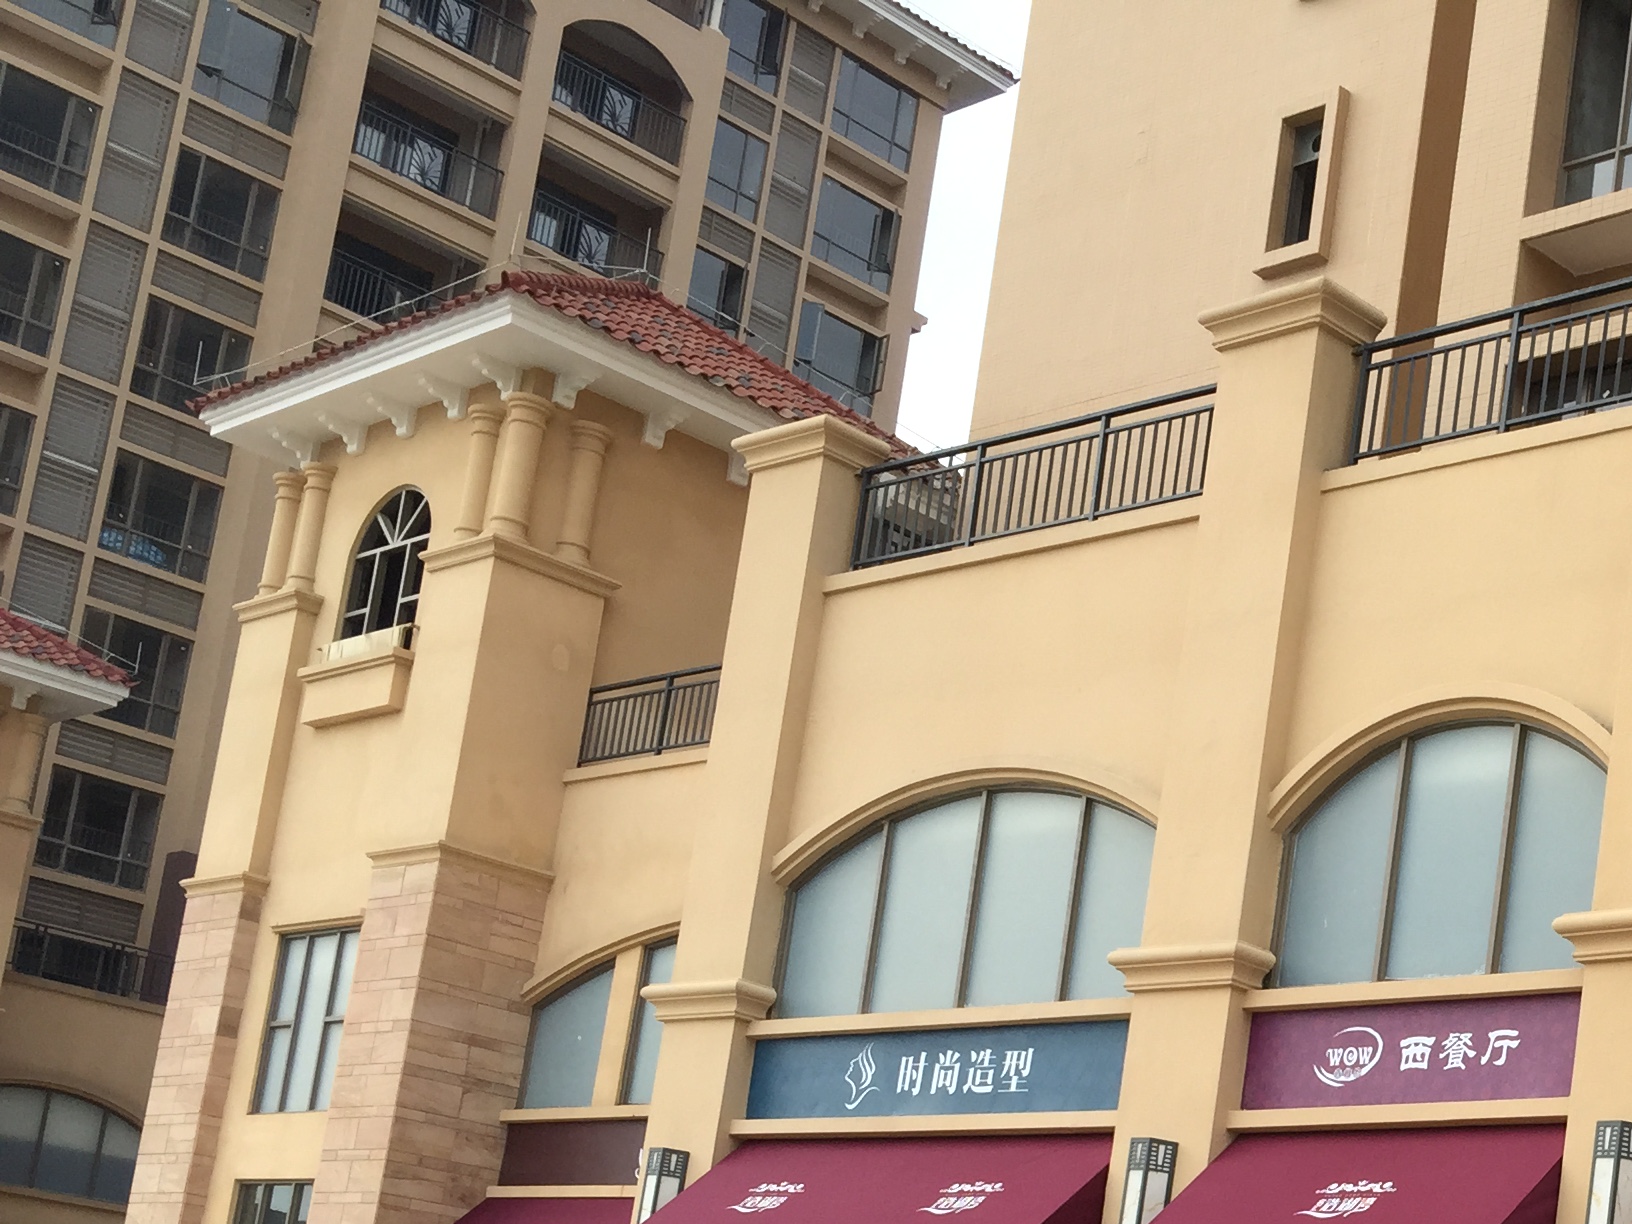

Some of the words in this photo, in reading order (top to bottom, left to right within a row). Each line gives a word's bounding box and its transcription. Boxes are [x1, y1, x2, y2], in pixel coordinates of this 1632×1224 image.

[895, 1047, 1035, 1097] 时尚造型
[1325, 1046, 1374, 1067] WOW
[1399, 1029, 1521, 1072] 西餐厅
